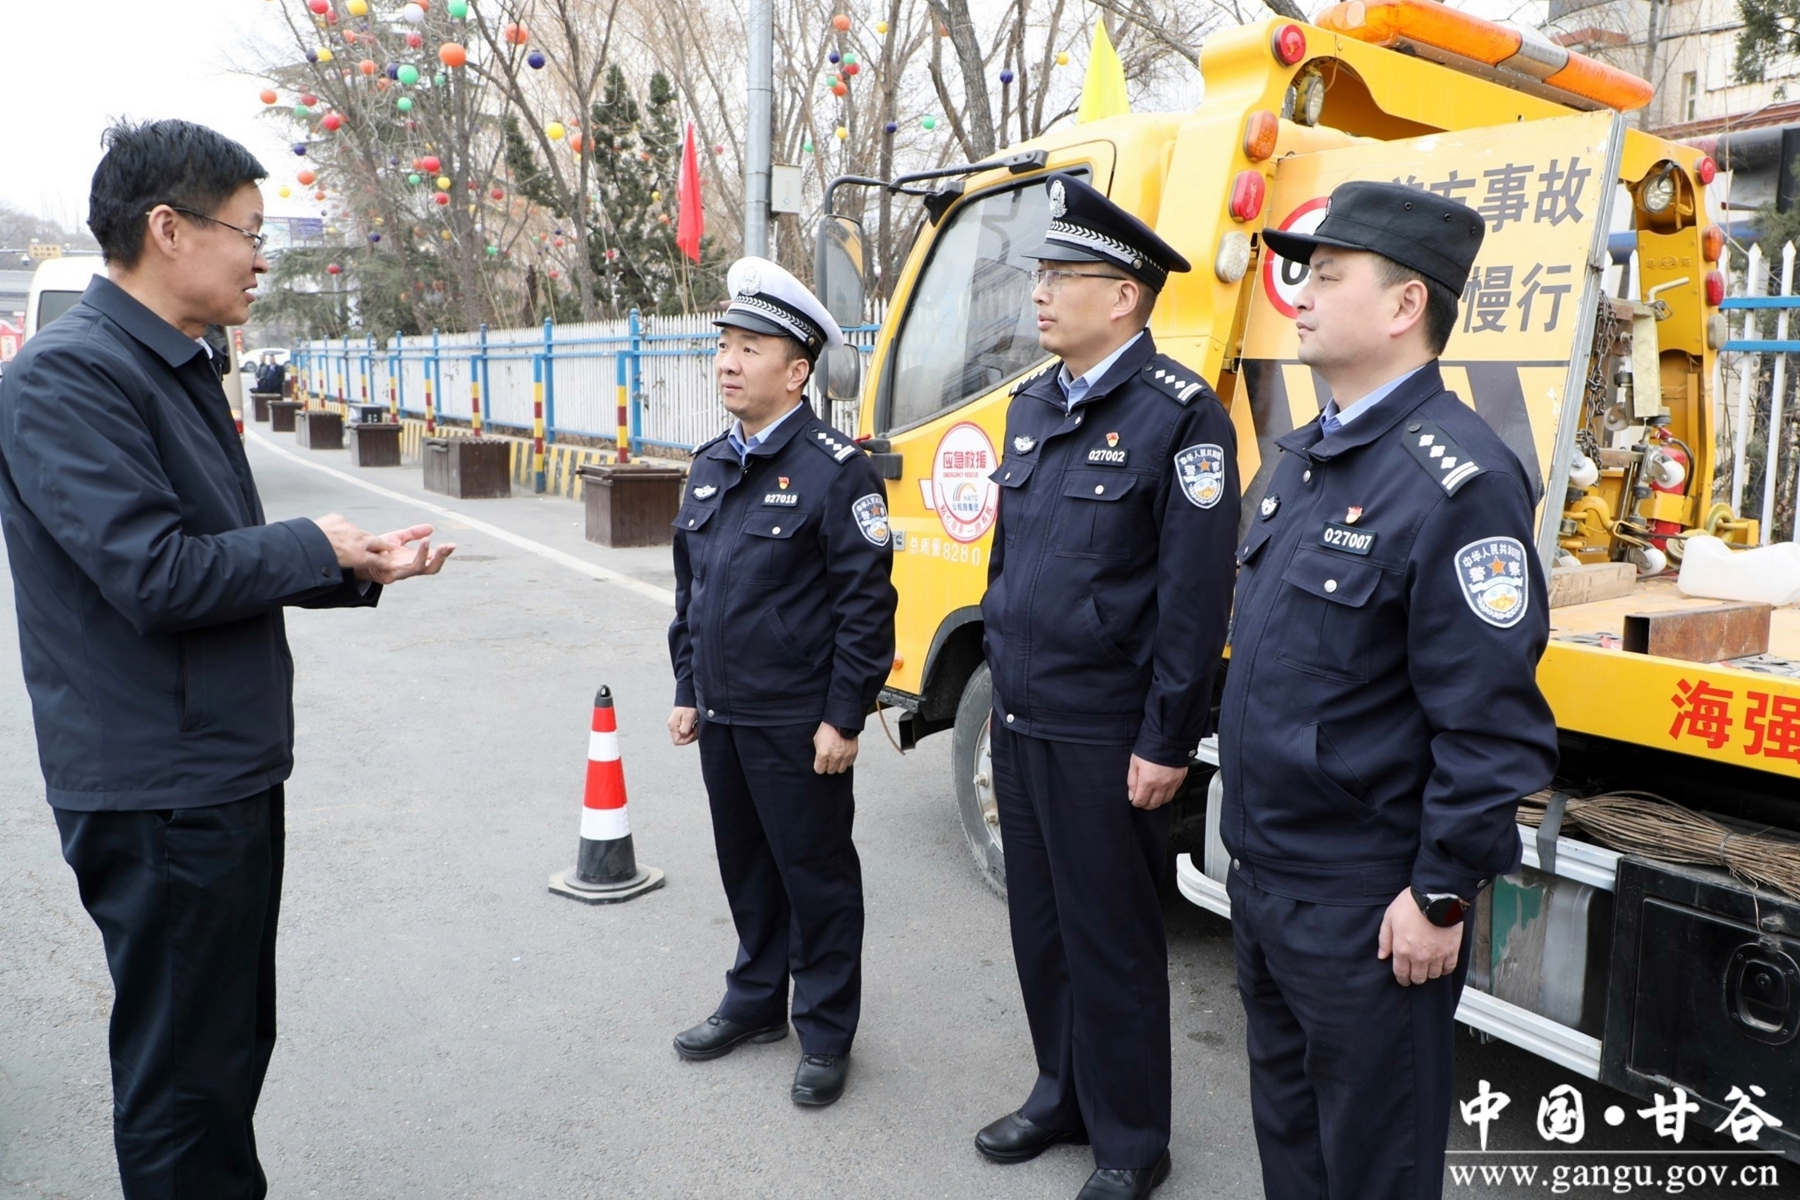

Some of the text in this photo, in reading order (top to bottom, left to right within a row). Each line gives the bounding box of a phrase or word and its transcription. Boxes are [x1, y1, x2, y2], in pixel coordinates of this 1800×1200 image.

[1391, 156, 1592, 233] 方事故
[1460, 262, 1572, 333] 慢行
[943, 450, 986, 469] 应急救援
[1088, 449, 1125, 463] 027002
[764, 494, 797, 504] 027019
[1324, 528, 1372, 550] 027007
[1462, 543, 1522, 567] 中华人民共和国
[1669, 678, 1800, 764] 海强
